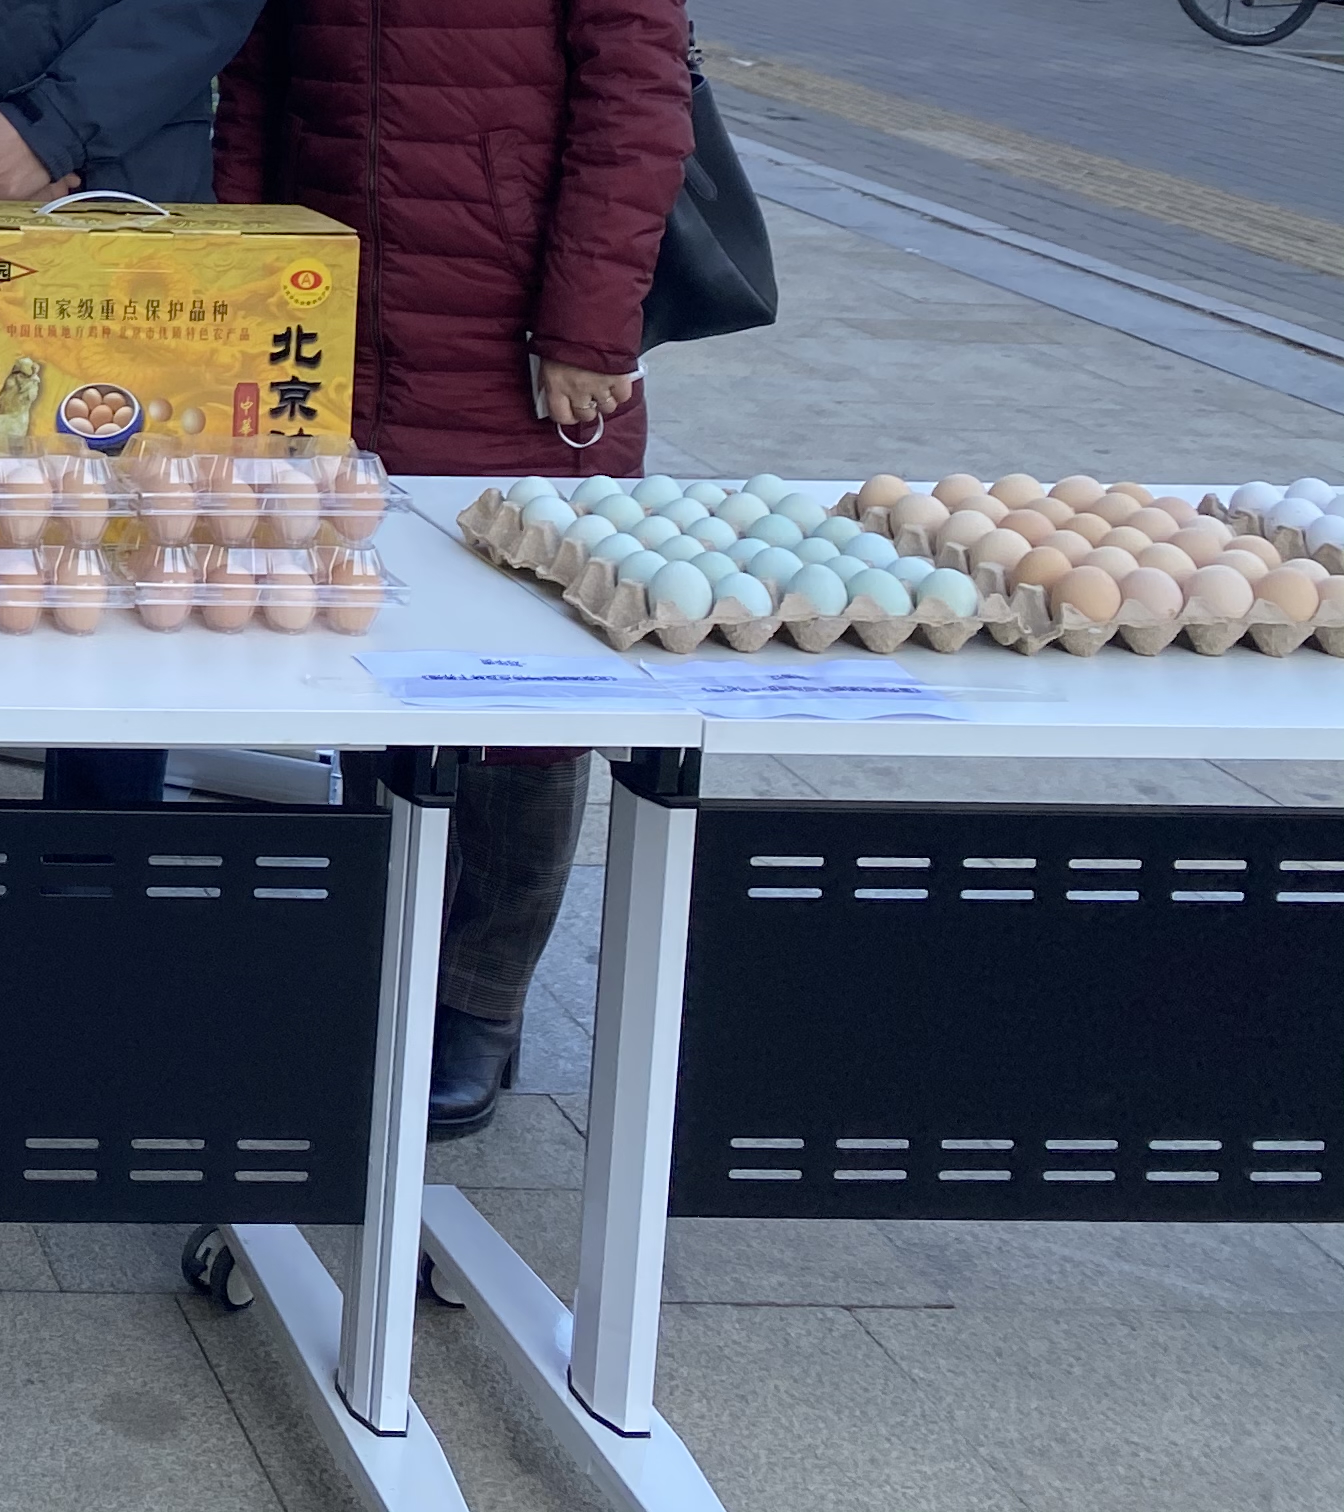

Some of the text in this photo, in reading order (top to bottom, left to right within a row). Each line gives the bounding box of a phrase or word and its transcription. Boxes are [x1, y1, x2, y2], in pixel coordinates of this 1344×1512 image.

[33, 297, 229, 322] 国家级重点保护品种
[269, 324, 322, 437] 北京
